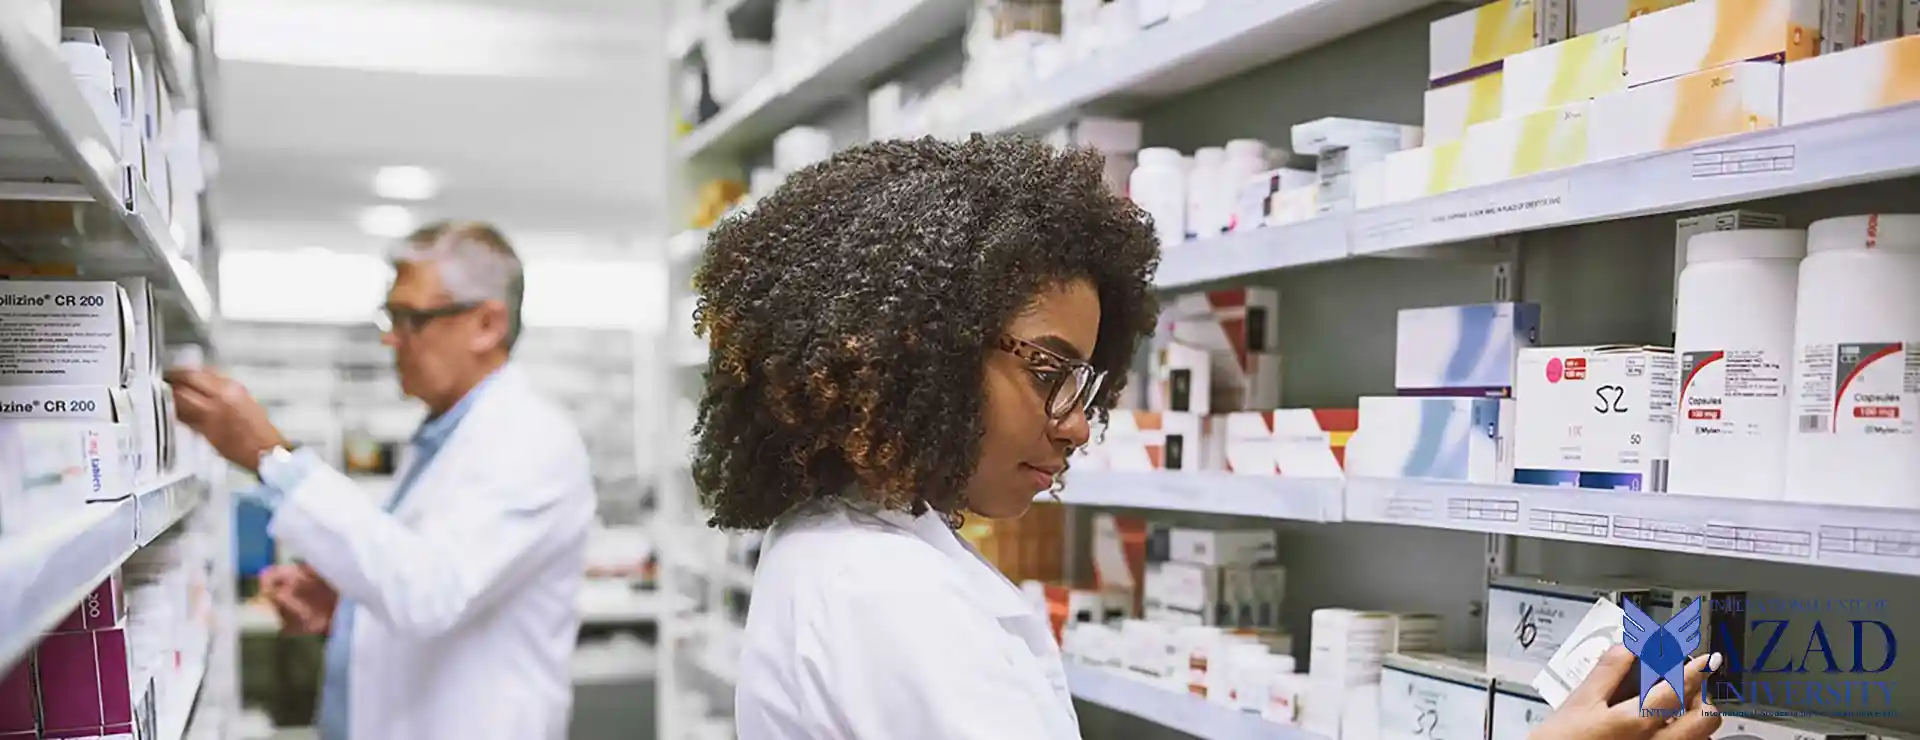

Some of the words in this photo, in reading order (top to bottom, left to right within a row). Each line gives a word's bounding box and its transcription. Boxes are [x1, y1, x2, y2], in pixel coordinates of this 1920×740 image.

[55, 295, 76, 306] CR
[80, 295, 104, 306] 200
[1594, 385, 1628, 413] 52
[1688, 397, 1722, 406] Capsules
[1854, 393, 1900, 403] Capsules
[44, 400, 66, 412] CR
[70, 400, 95, 412] 200
[1704, 411, 1718, 420] mg
[1860, 407, 1877, 416] 100
[1878, 408, 1895, 418] mg
[1700, 427, 1721, 435] Mylan
[1873, 426, 1899, 434] Mylan
[1630, 434, 1641, 444] 50
